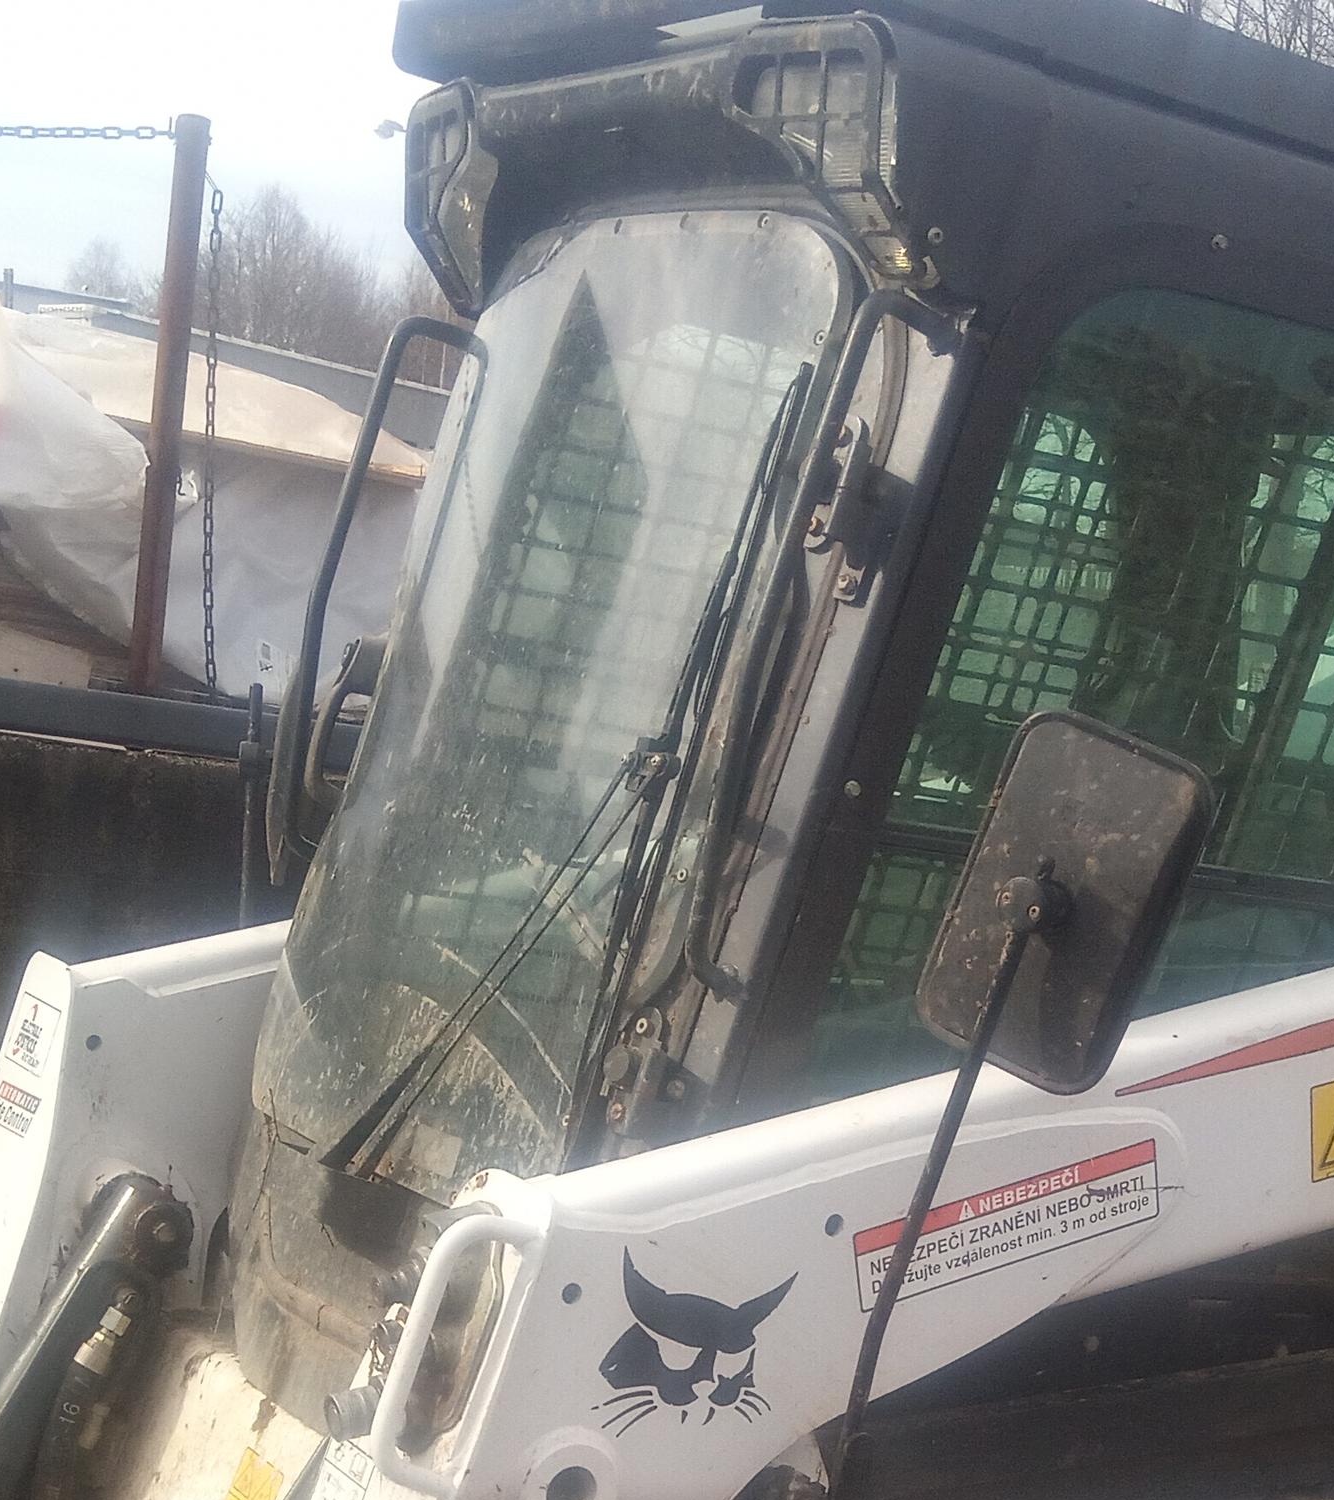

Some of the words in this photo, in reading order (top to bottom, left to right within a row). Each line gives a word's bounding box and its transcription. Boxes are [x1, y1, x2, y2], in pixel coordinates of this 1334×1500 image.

[3, 1105, 33, 1134] Control
[870, 1229, 964, 1276] NEBZPEČÍ
[969, 1206, 1042, 1243] ZRANĚNÍ
[1046, 1193, 1091, 1220] NEBO
[1096, 1175, 1144, 1204] SMRTI
[978, 1165, 1080, 1214] NEBEZPEČÍ
[871, 1263, 941, 1294] Džujte
[946, 1237, 1023, 1269] vzdálenost
[1026, 1223, 1057, 1245] min.
[1060, 1219, 1069, 1234] 3
[1072, 1216, 1085, 1230] m
[1089, 1207, 1107, 1224] od
[1110, 1194, 1150, 1217] stroje
